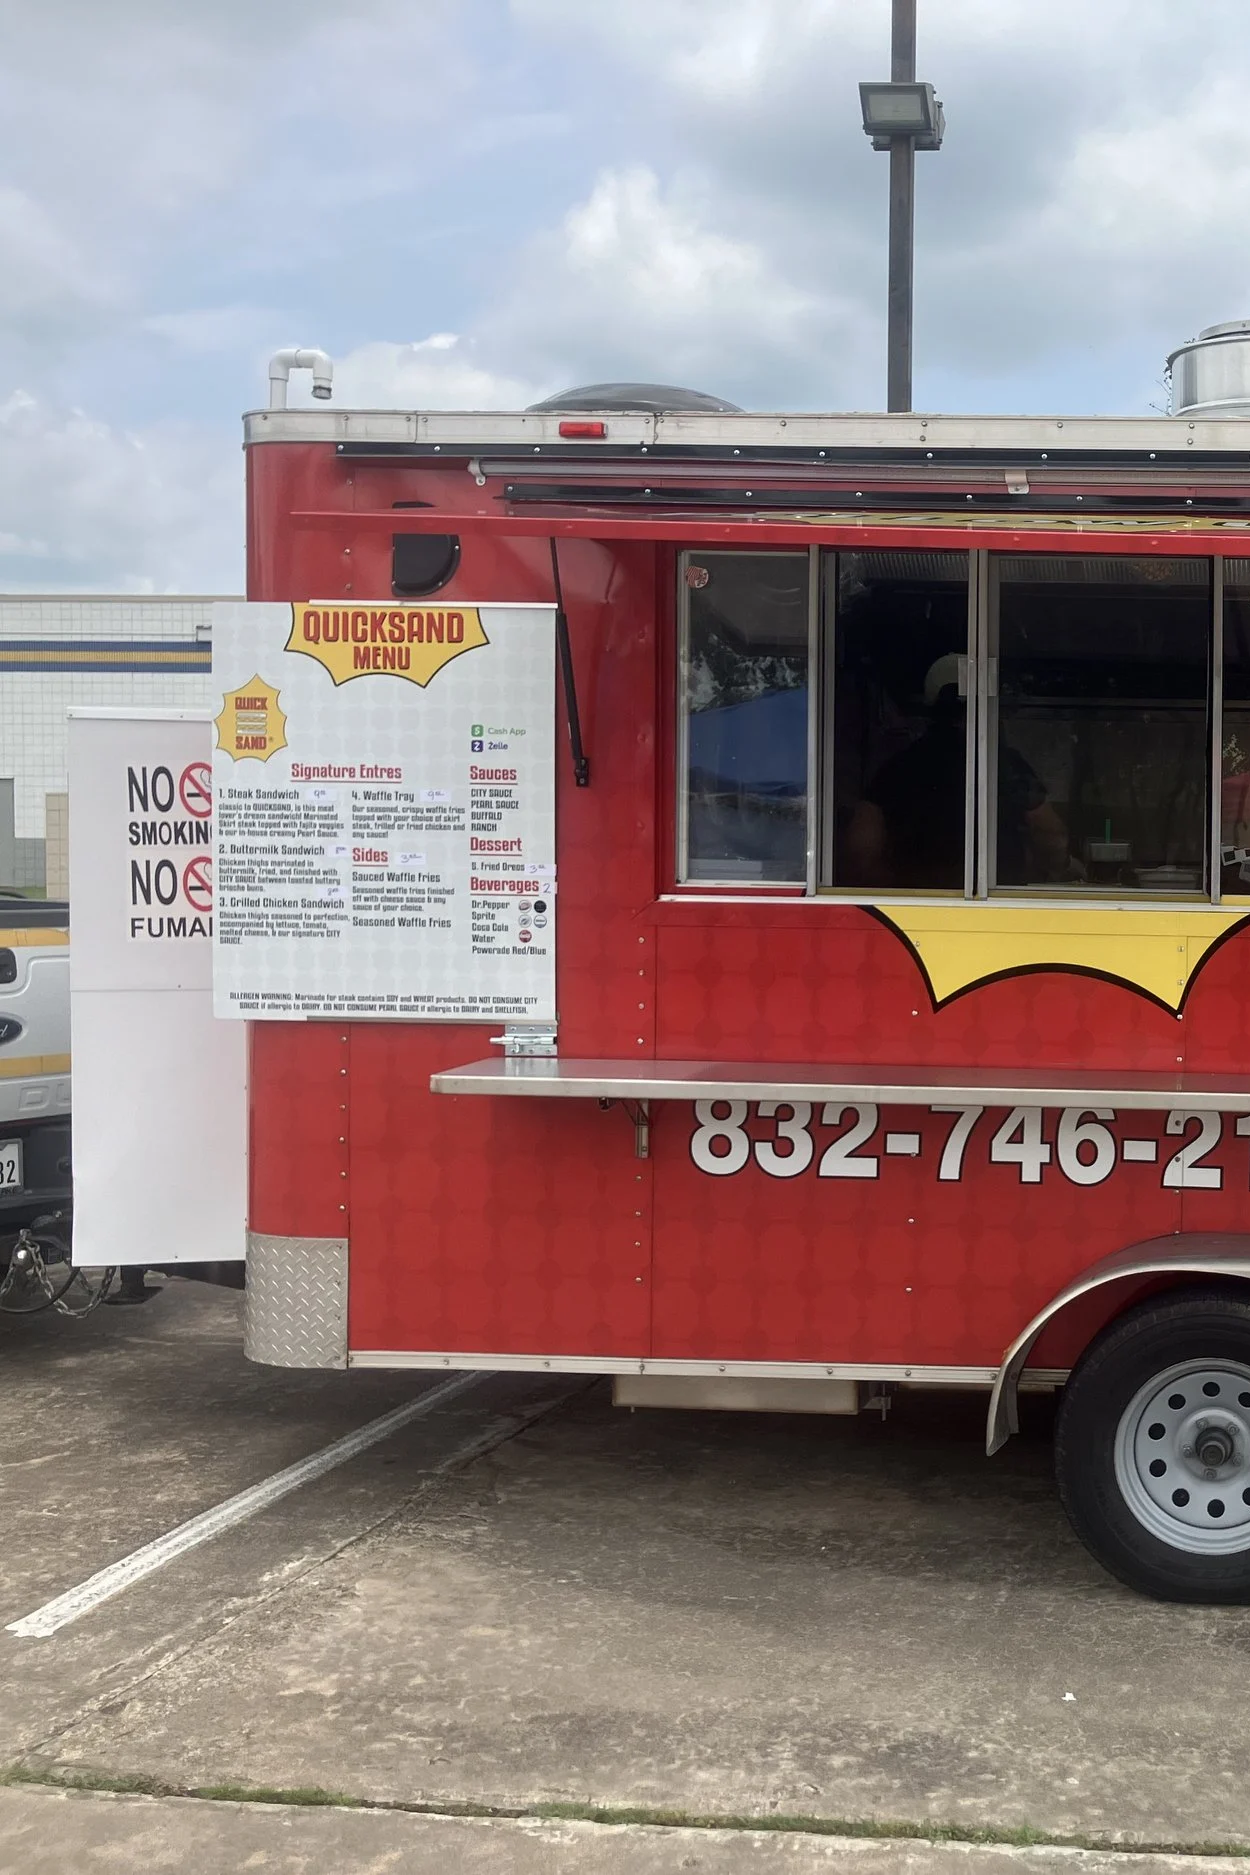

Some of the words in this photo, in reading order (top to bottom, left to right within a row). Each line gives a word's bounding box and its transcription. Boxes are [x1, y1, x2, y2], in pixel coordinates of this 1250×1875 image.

[303, 611, 464, 644] QUICKSAND
[354, 646, 410, 670] MENU
[235, 697, 268, 711] QUICK
[510, 728, 526, 736] App
[235, 736, 267, 750] SAND
[292, 763, 356, 780] Signature
[360, 765, 402, 778] Entres
[470, 766, 517, 780] Sauces
[128, 766, 174, 812] NO
[228, 789, 252, 798] Steak
[256, 790, 299, 799] Sandwich
[471, 789, 487, 797] CITY
[489, 789, 512, 797] SAUCE
[352, 791, 361, 800] 4.
[364, 791, 392, 800] Waffle
[395, 791, 414, 802] Tray
[471, 800, 493, 809] PEARL
[496, 801, 519, 809] SAUCE
[471, 812, 502, 820] BUFFALO
[471, 823, 497, 831] RANCH
[129, 821, 212, 845] SMOKIN
[219, 844, 227, 853] 2.
[231, 844, 278, 854] Buttermilk
[282, 845, 324, 855] Sandwich
[471, 837, 522, 851] Dessert
[353, 848, 388, 862] Sides
[503, 863, 525, 871] Oreos
[131, 859, 177, 905] NO
[353, 872, 384, 881] Sauced
[387, 873, 415, 882] Waffle
[471, 877, 539, 893] Beverages
[220, 897, 227, 907] 3.
[231, 898, 260, 908] Grilled
[263, 898, 298, 908] Chicken
[301, 899, 344, 909] Sandwich
[472, 901, 510, 909] Dr.Pepper
[472, 912, 495, 920] Sprite
[131, 917, 212, 938] FUMA
[353, 917, 395, 926] Seasoned
[398, 917, 426, 927] Waffle
[472, 923, 490, 931] Coca
[492, 923, 508, 931] Cola
[472, 935, 495, 943] Water
[472, 946, 510, 954] Powerade
[513, 947, 546, 955] Red/Blue
